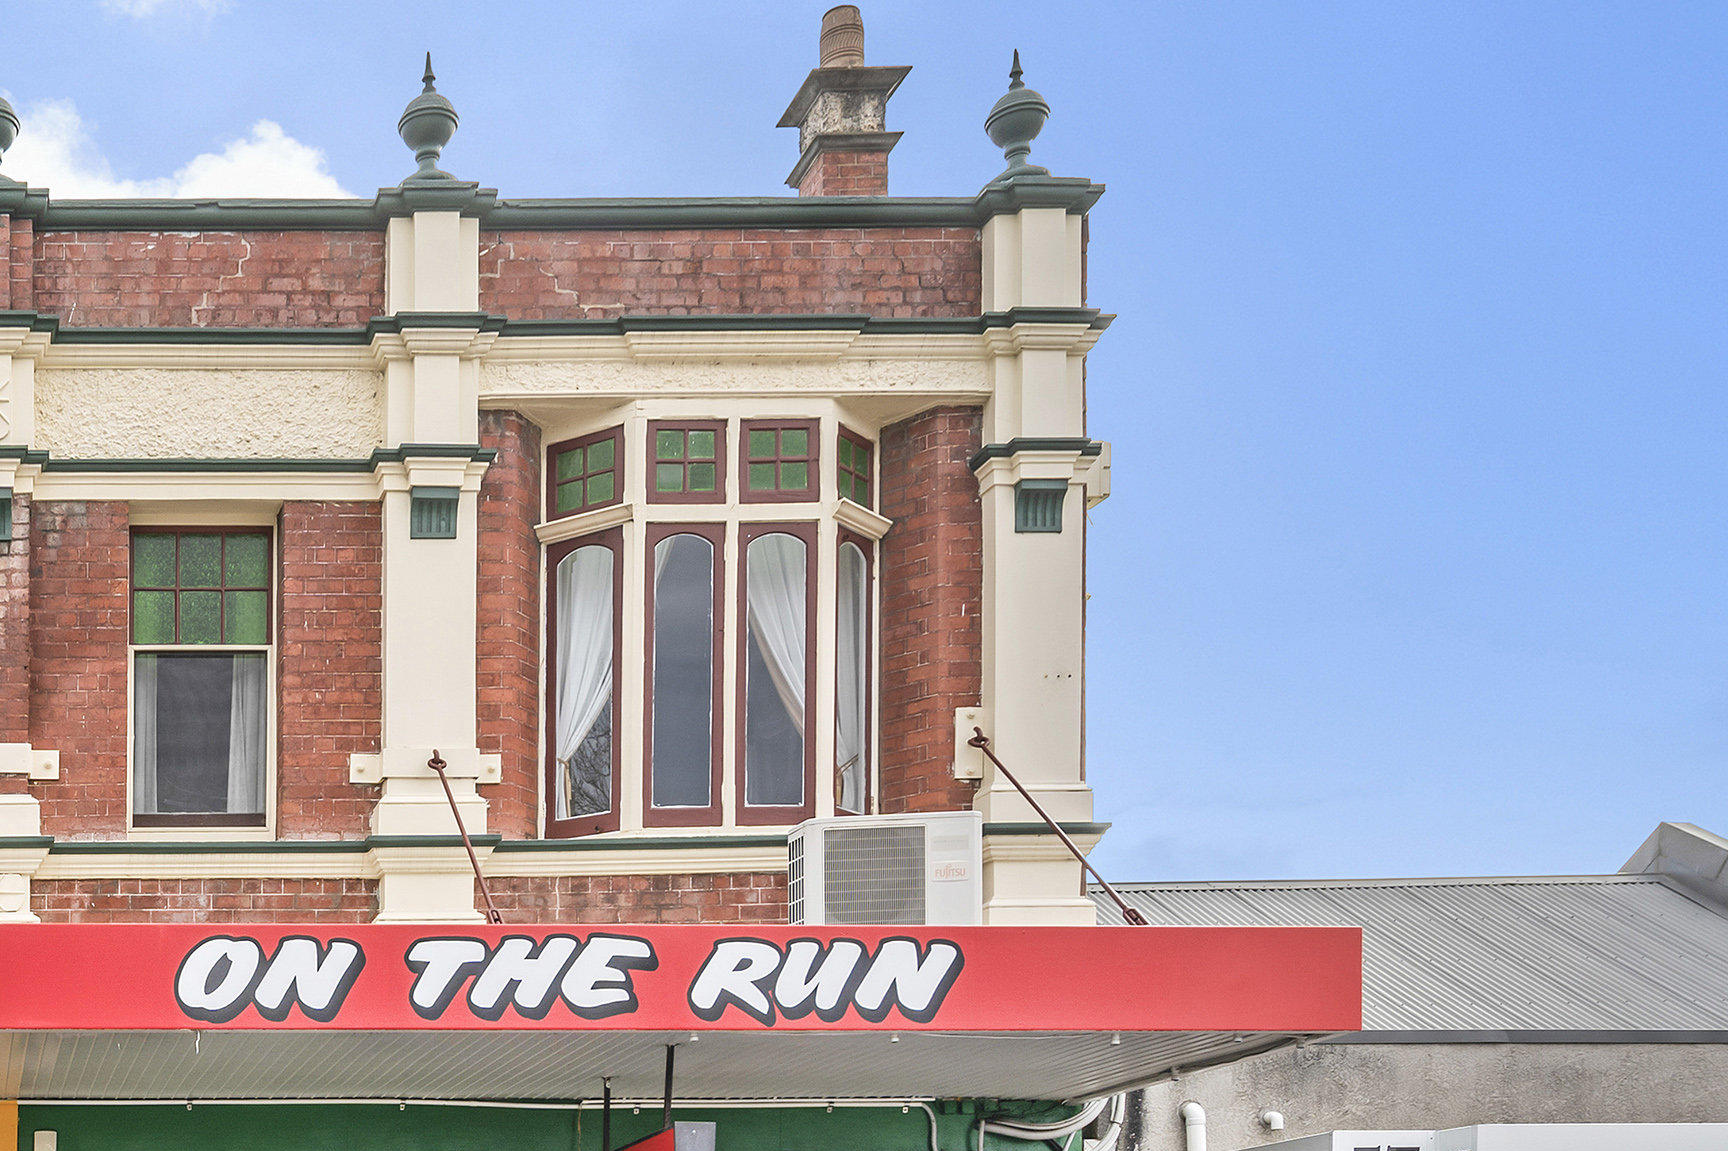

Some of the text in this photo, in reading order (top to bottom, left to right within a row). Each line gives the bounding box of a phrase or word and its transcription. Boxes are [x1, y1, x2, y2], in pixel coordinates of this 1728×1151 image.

[934, 863, 966, 879] FUJITSU
[174, 934, 964, 1027] ON THE RUN
